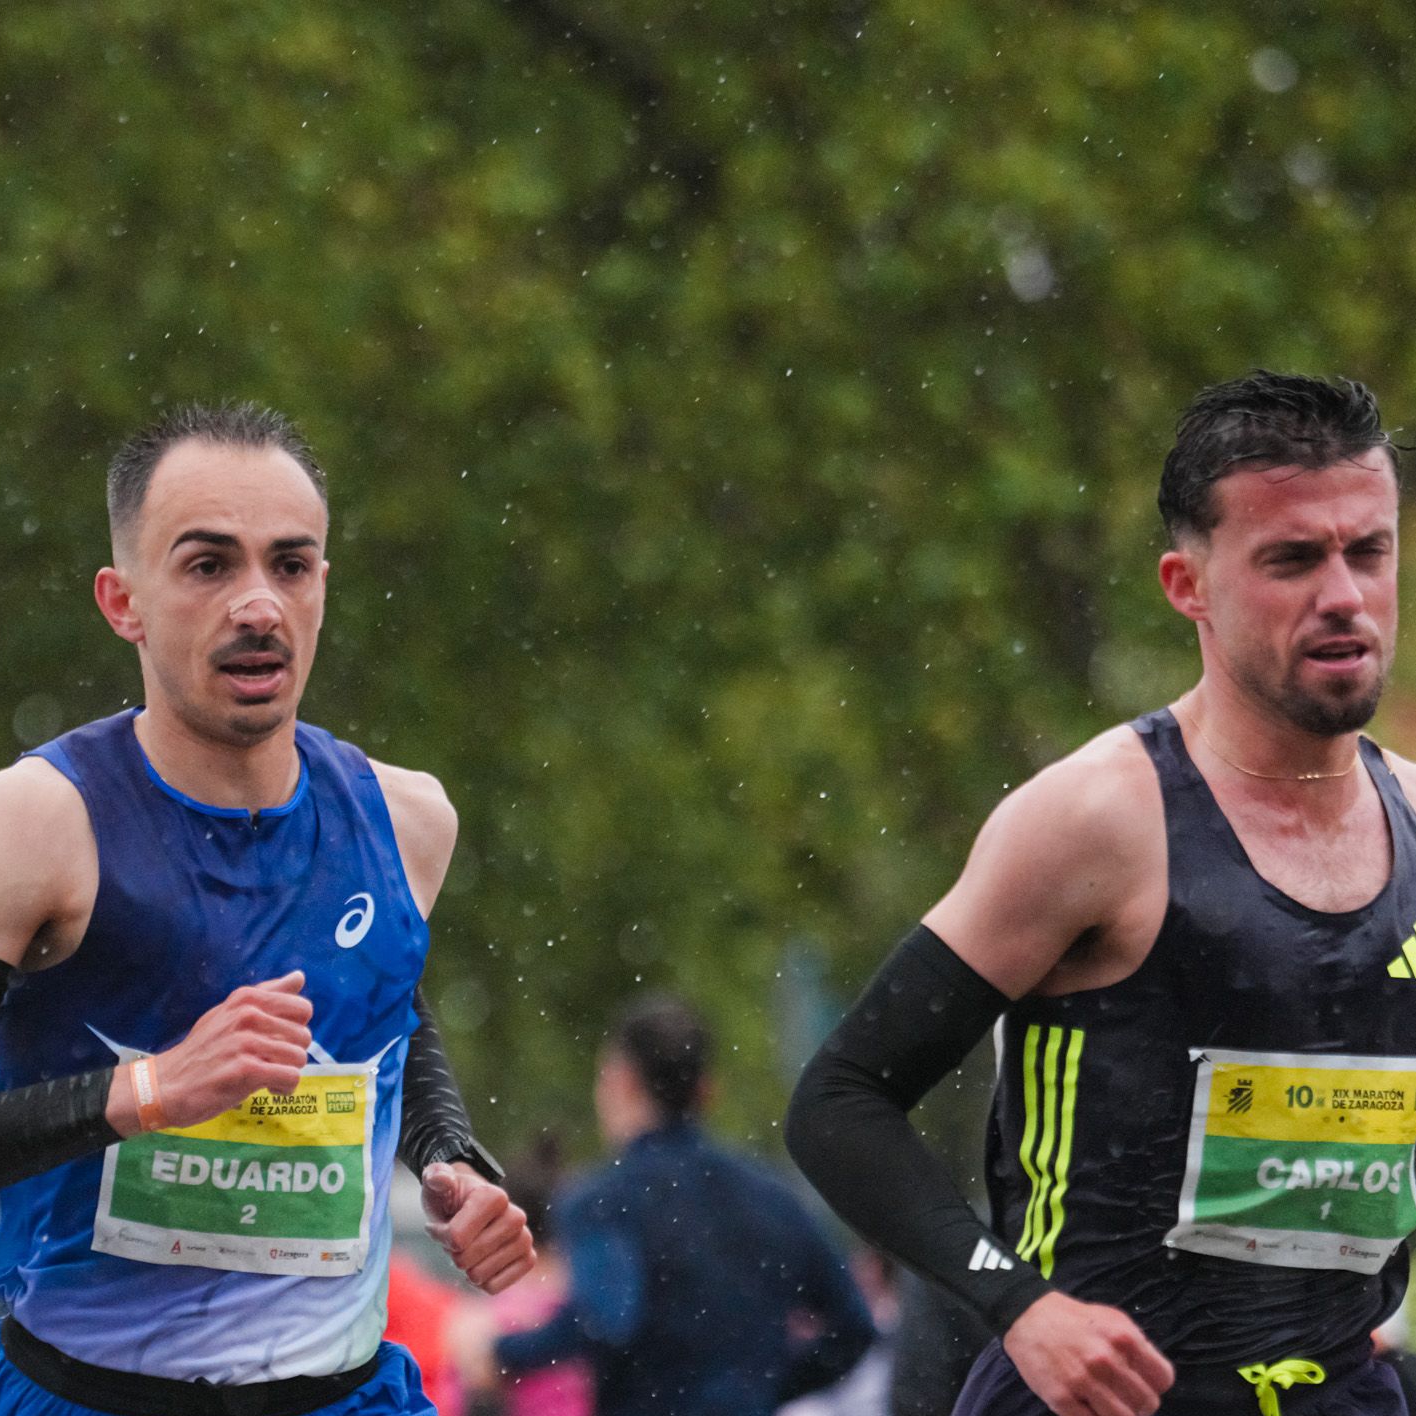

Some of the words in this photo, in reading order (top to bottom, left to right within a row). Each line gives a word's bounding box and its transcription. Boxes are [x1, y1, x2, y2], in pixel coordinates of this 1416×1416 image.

[251, 1096, 269, 1105] XIX
[273, 1093, 317, 1105] MARATÓN
[1285, 1085, 1313, 1108] 10
[1333, 1089, 1350, 1099] XIX
[1353, 1088, 1404, 1100] MARATÓN
[250, 1106, 265, 1115] DE
[267, 1105, 318, 1115] ZARAGOZA
[1333, 1100, 1346, 1109] DE
[1348, 1101, 1404, 1111] ZARAGOZA
[151, 1150, 345, 1194] EDUARDO
[1257, 1157, 1405, 1194] CARLOS
[240, 1204, 258, 1224] 2
[1320, 1201, 1332, 1220] 1
